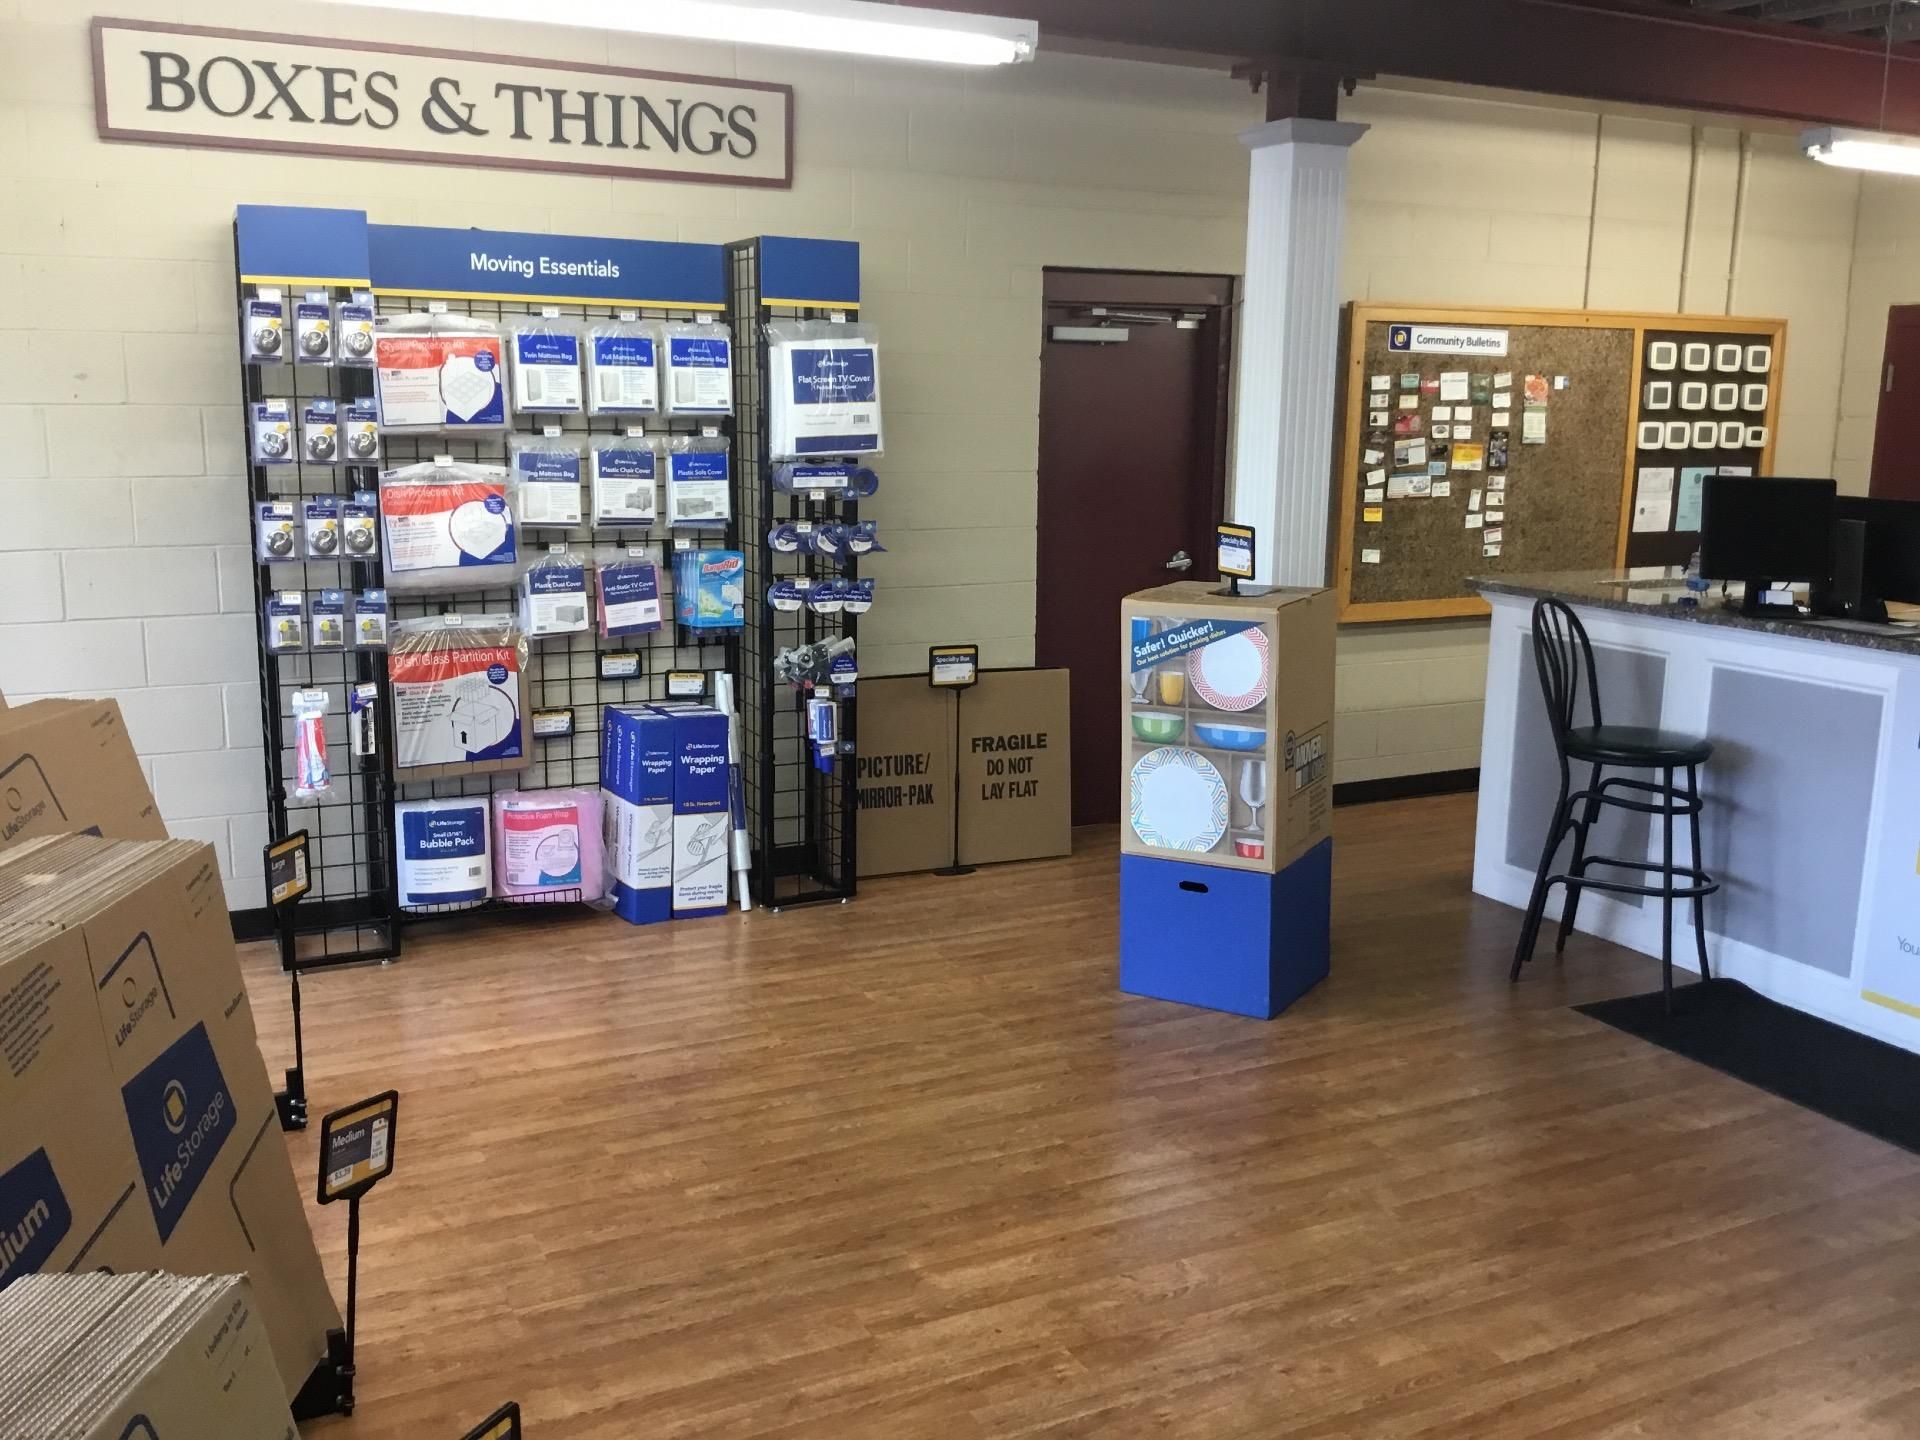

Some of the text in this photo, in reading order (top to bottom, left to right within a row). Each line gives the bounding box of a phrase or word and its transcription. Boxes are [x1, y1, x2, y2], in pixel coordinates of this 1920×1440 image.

[140, 50, 757, 160] BOXES & THINGS
[471, 253, 620, 279] Moving Essentials
[1416, 334, 1501, 348] Community Bulletins
[561, 353, 573, 361] Bag
[798, 374, 871, 384] Flat Screen TV Cover
[602, 466, 619, 474] Plastic
[634, 467, 651, 475] Cover
[452, 486, 464, 497] Kit
[1221, 534, 1249, 547] Specialty Box
[534, 581, 550, 589] Plastic
[605, 584, 631, 592] Anti-Static
[1133, 621, 1214, 658] Safer! Quicker!
[452, 651, 494, 664] Partition
[496, 649, 511, 661] Kit
[1136, 658, 1147, 666] Our
[1189, 636, 1210, 648] packing
[935, 655, 960, 663] Specialty
[971, 733, 1048, 753] FRAGILE
[641, 759, 672, 767] Wrapping
[680, 754, 725, 766] Wrapping
[857, 752, 931, 779] PICTURE/
[986, 756, 1034, 776] DO NOT
[647, 767, 667, 775] Paper
[689, 765, 716, 776] Paper
[855, 784, 935, 810] MIRROR-PAK
[981, 780, 1039, 801] LAY FLAT
[2, 800, 47, 841] LifeStorage
[536, 811, 553, 820] Foam
[419, 836, 475, 849] Bubble Pack
[115, 988, 158, 1047] LifeStorage
[332, 1128, 365, 1148] Medium
[153, 1091, 225, 1209] LifeStorage
